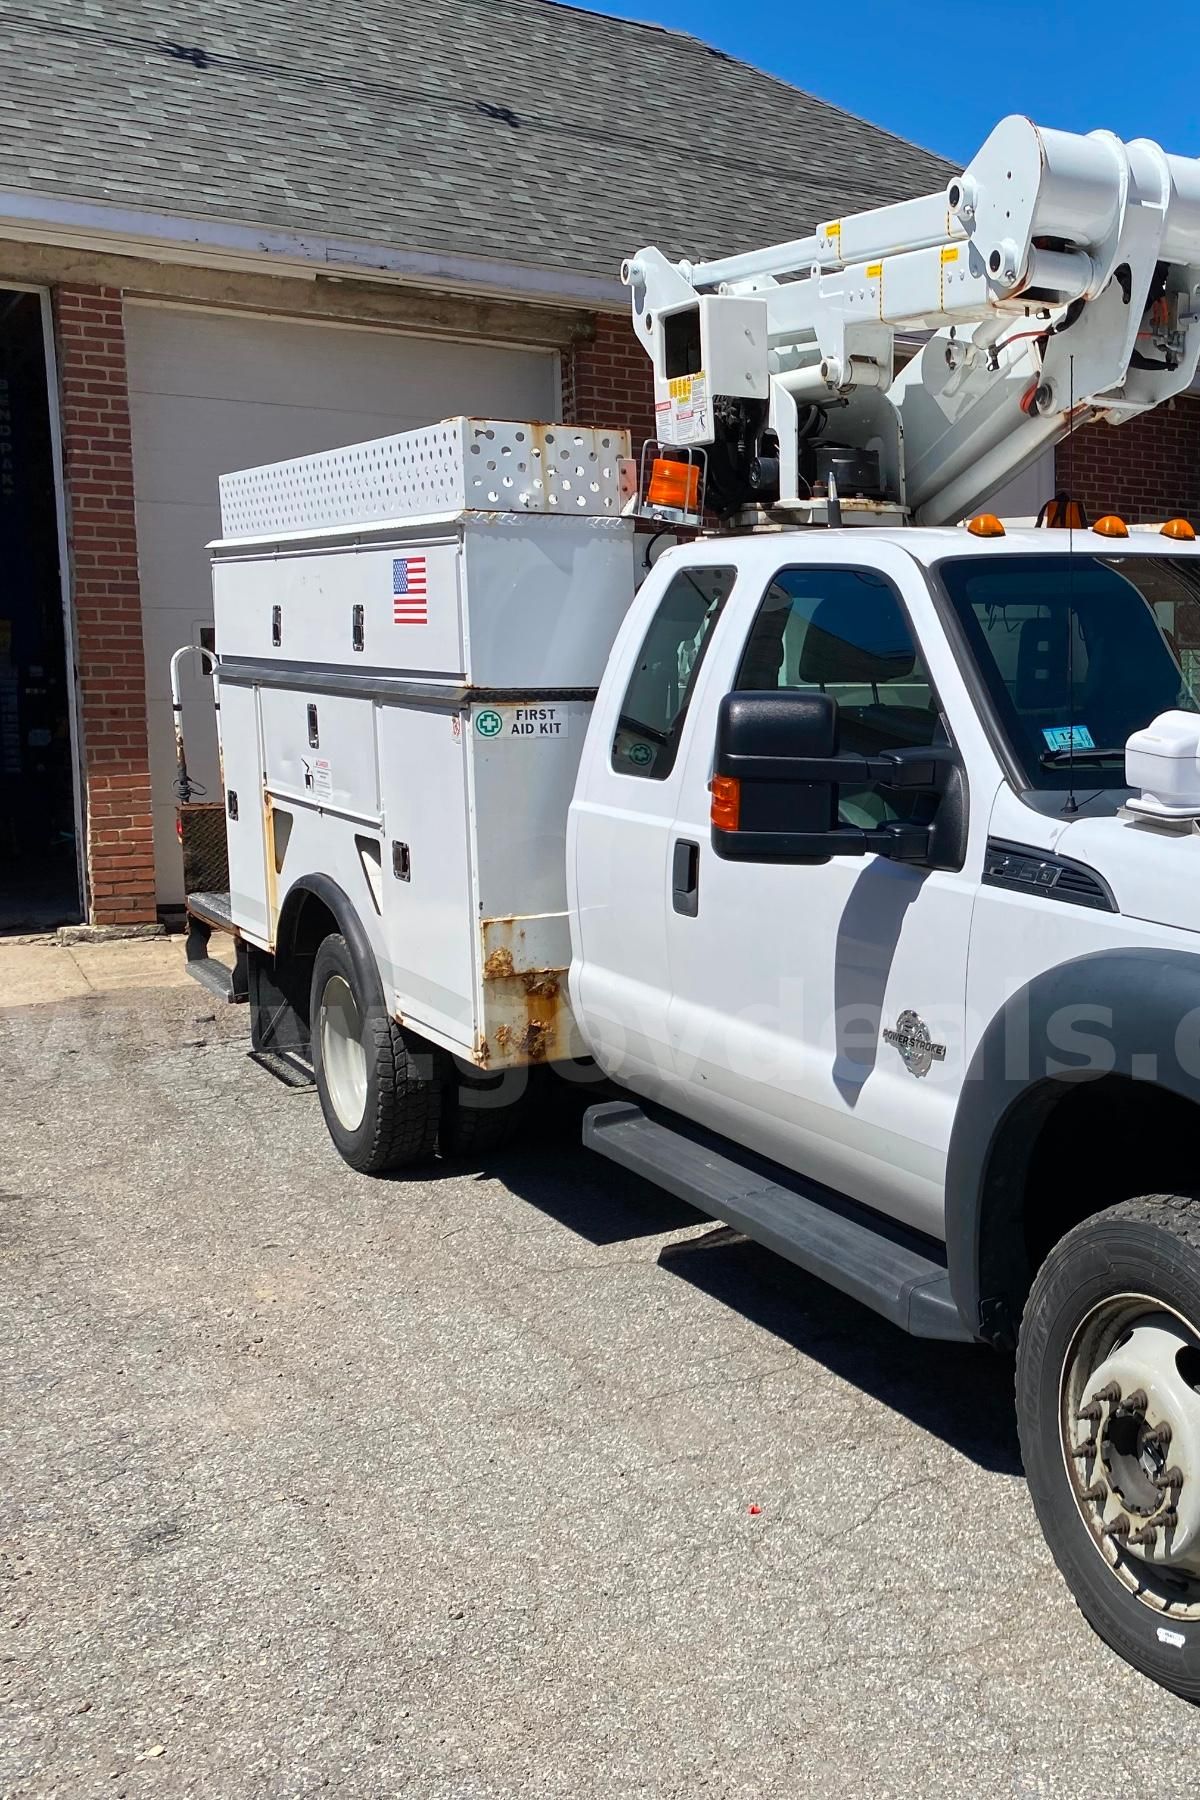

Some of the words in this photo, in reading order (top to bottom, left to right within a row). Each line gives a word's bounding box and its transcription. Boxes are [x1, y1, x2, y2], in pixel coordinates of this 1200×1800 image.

[515, 708, 556, 721] FIRST
[511, 723, 535, 735] AID
[539, 722, 562, 734] KIT
[909, 1037, 943, 1055] STROKE
